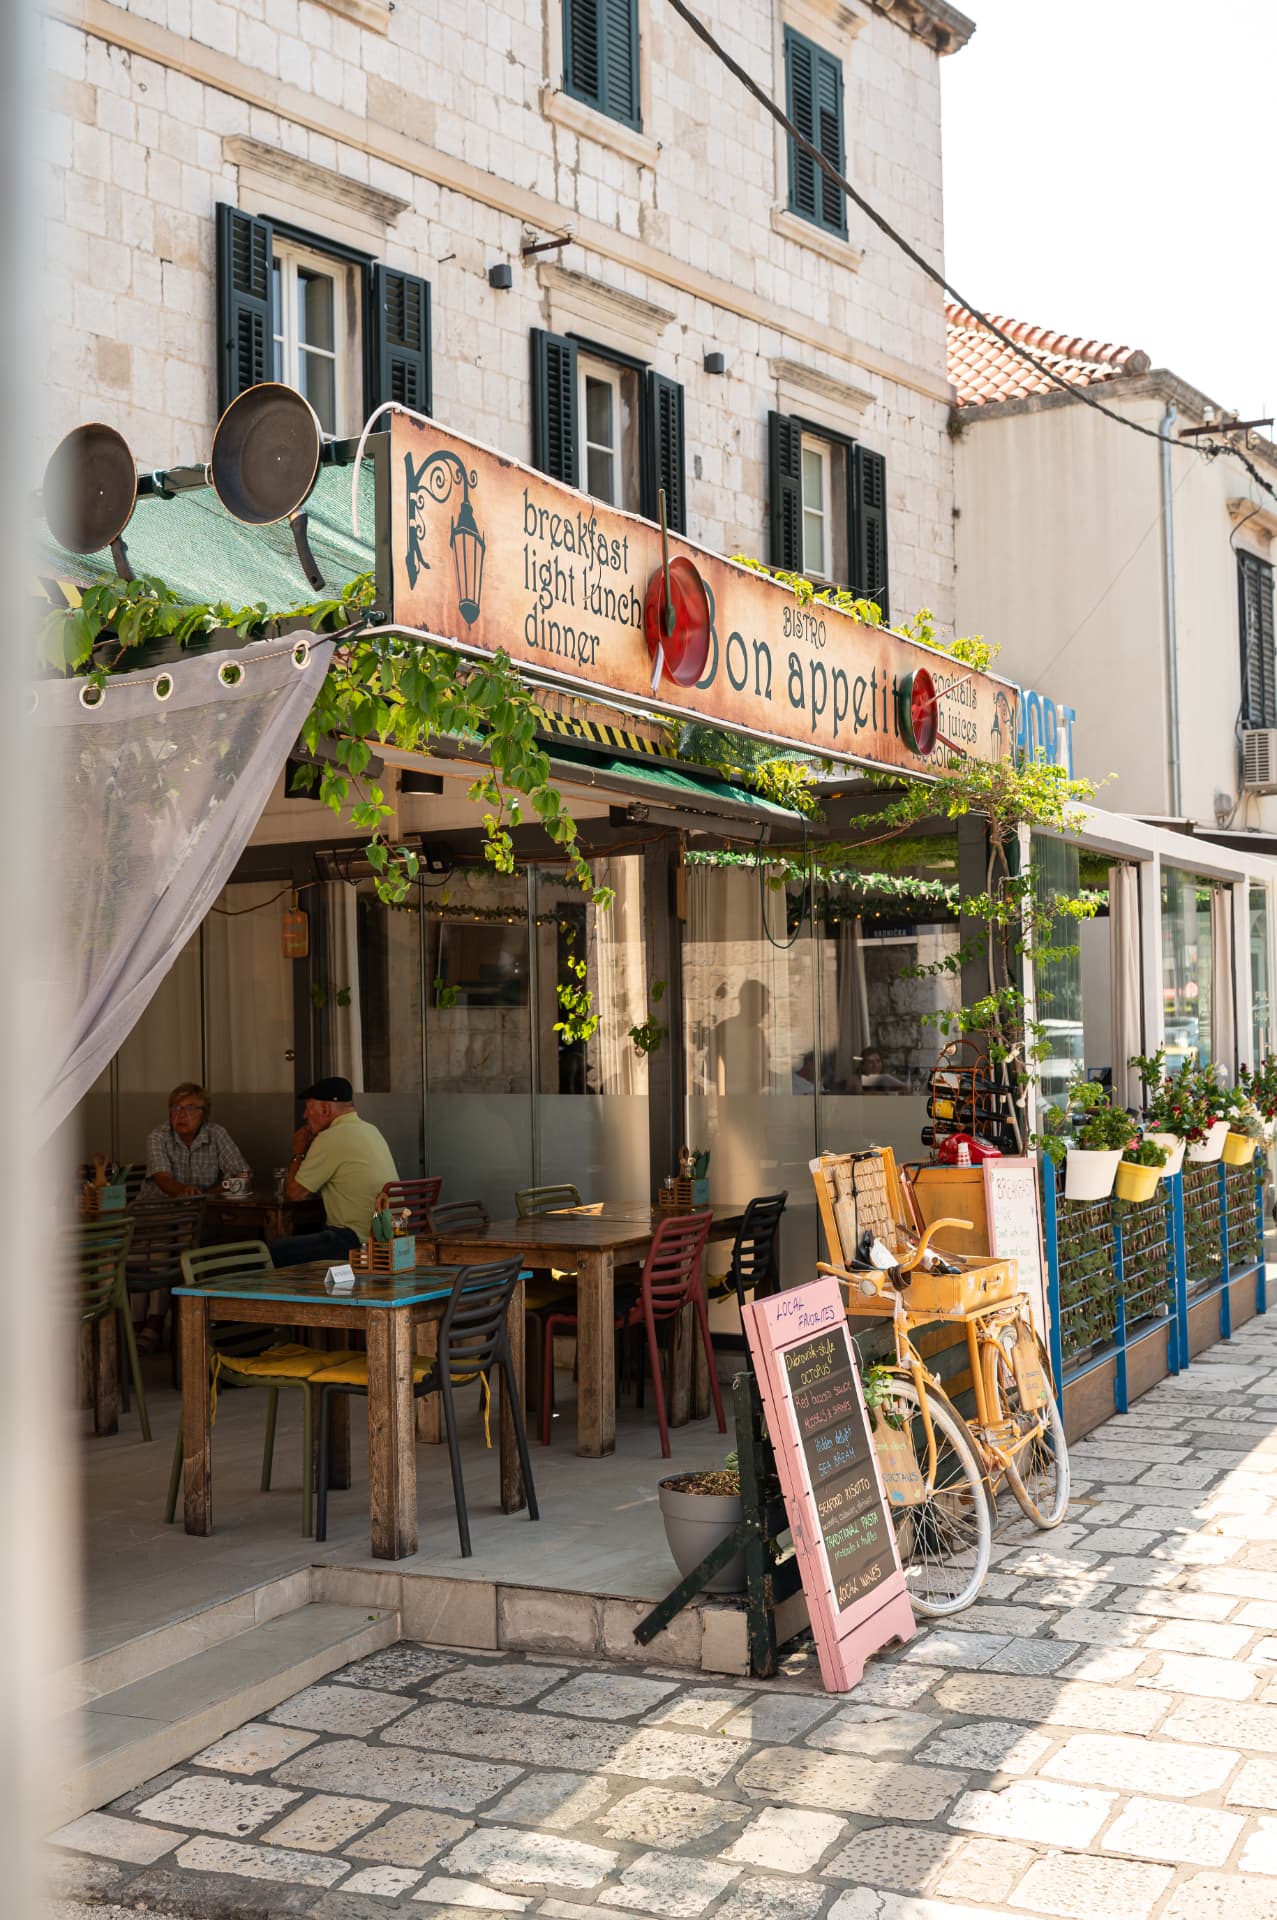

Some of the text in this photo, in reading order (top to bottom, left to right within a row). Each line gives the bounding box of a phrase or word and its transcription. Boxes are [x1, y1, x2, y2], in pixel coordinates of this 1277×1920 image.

[523, 488, 629, 575] breakfast
[524, 544, 642, 631] light lunch
[525, 603, 600, 667] dinner
[783, 606, 827, 650] BISTRO
[788, 651, 899, 738] appetit
[948, 707, 977, 744] juices
[776, 1297, 805, 1321] LOCAL
[798, 1305, 835, 1329] FAVORITES
[800, 1362, 831, 1386] OCTOPUS
[795, 1393, 809, 1409] Red
[818, 1493, 843, 1517] SEAFOOD
[845, 1478, 870, 1501] RISOTTO
[861, 1511, 879, 1530] PASTA
[838, 1563, 882, 1606] LOCAL WINES
